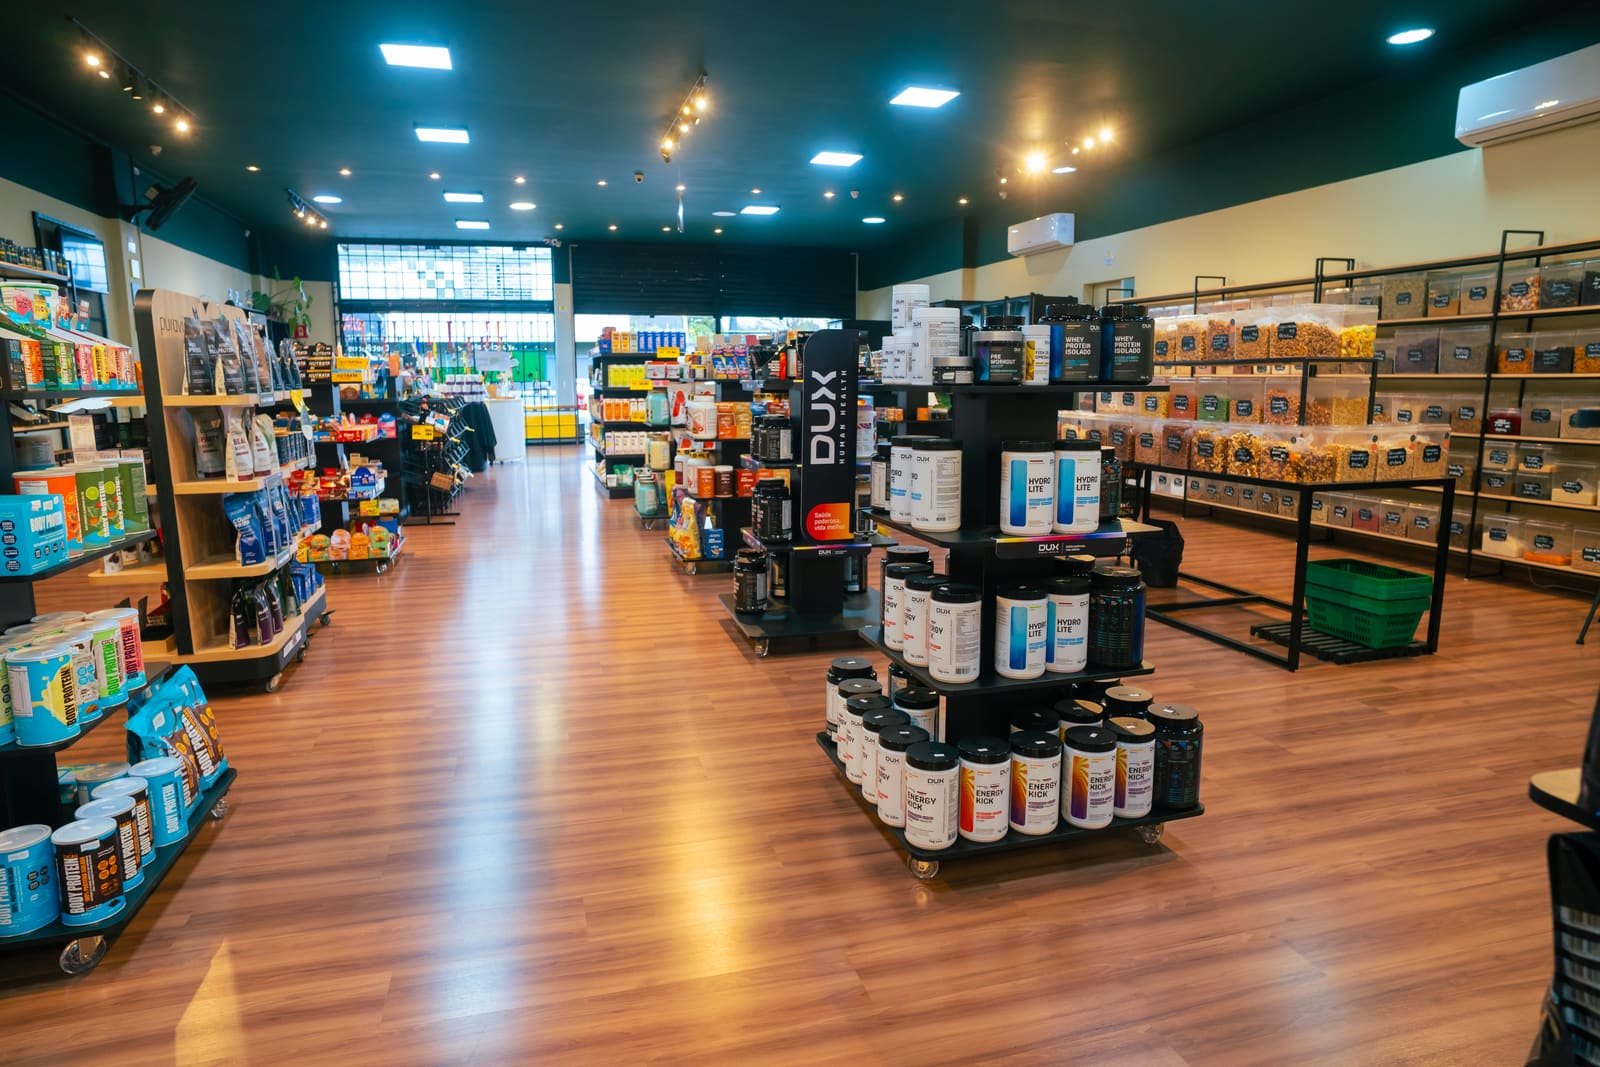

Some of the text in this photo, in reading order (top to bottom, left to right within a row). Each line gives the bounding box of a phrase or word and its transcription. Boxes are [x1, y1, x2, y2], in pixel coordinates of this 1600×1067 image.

[160, 316, 184, 336] purav
[840, 370, 848, 416] HEALTH
[810, 370, 836, 464] DUX
[1028, 477, 1050, 485] HYDRO
[1076, 476, 1098, 484] HYDRO
[1038, 544, 1059, 552] DUX
[912, 596, 926, 604] DUX
[1057, 618, 1081, 626] HYDRO
[1028, 630, 1042, 638] LITE
[122, 630, 139, 680] BODY PROTEIN
[102, 644, 120, 696] BODY PROTEIN
[60, 668, 77, 726] BODY PROTEIN
[196, 748, 214, 778] BODY
[1129, 765, 1152, 774] ENERGY
[976, 788, 1004, 797] ENERGY
[1028, 782, 1058, 790] ENERGY
[1028, 790, 1048, 798] KICK
[162, 784, 178, 814] PROTEIN
[908, 791, 936, 805] ENERGY
[908, 800, 922, 811] KICK
[976, 797, 994, 805] KICK
[136, 802, 152, 856] BODY PROTEIN
[166, 812, 179, 834] BODY
[120, 823, 138, 880] BODY PROTEIN
[63, 857, 82, 892] PROTEIN
[68, 892, 85, 914] BODY
[0, 904, 12, 925] BODY
